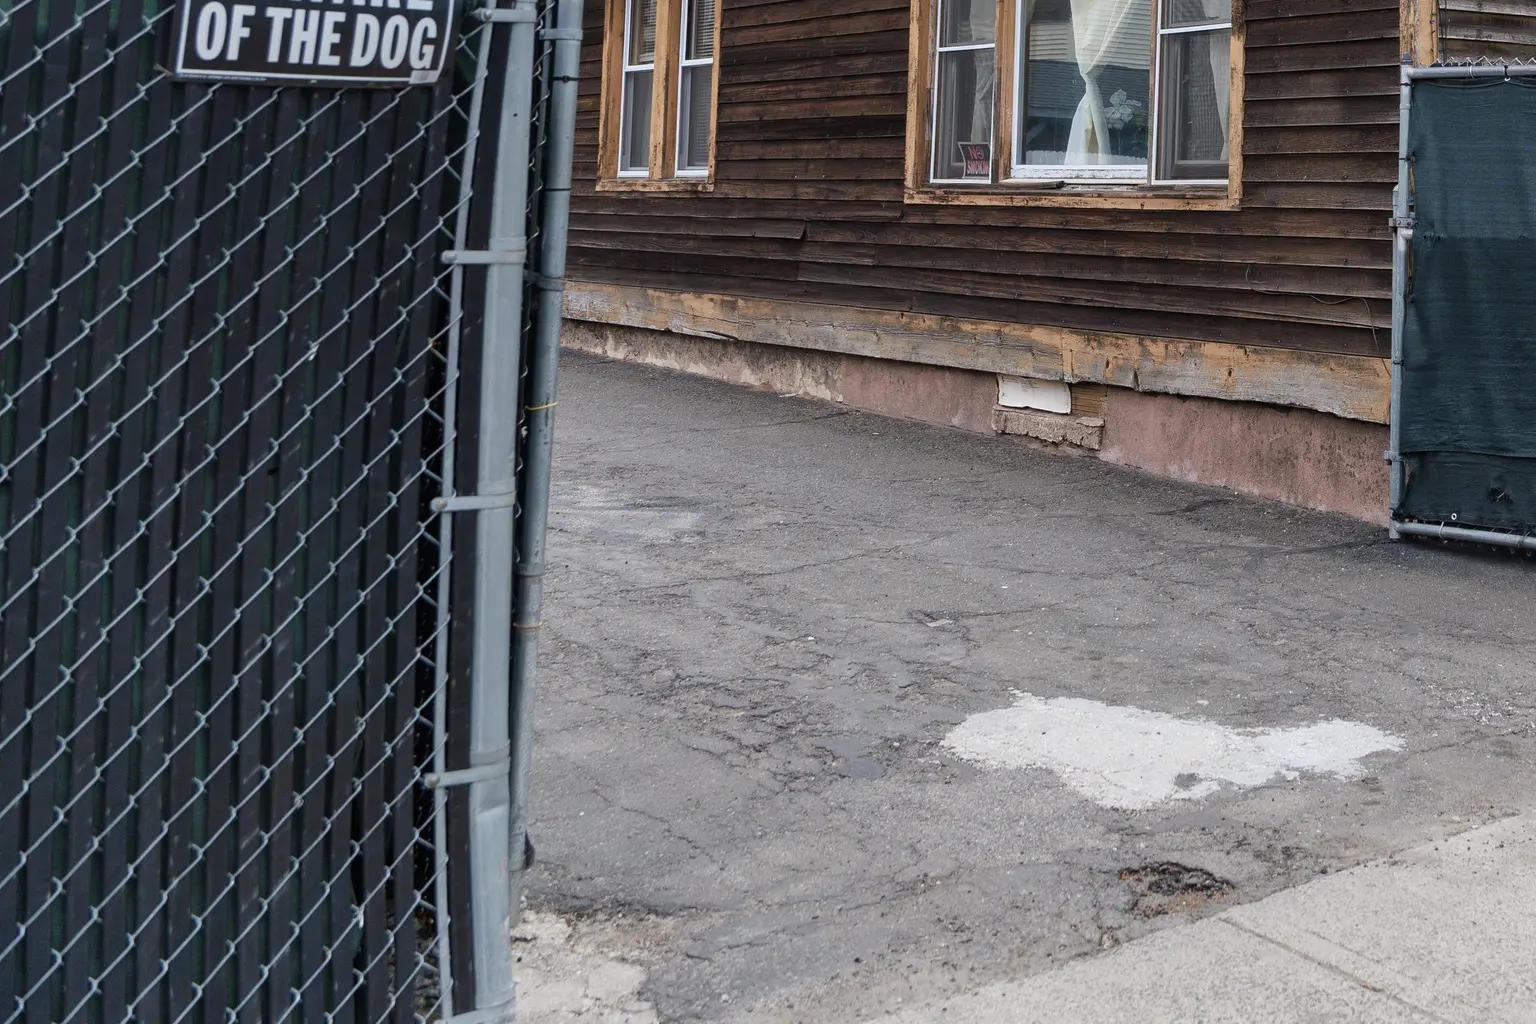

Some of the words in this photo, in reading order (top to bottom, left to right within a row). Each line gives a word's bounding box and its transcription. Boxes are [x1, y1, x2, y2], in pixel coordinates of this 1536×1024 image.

[195, 1, 256, 61] OF
[265, 7, 347, 66] THE
[349, 13, 438, 70] DOG
